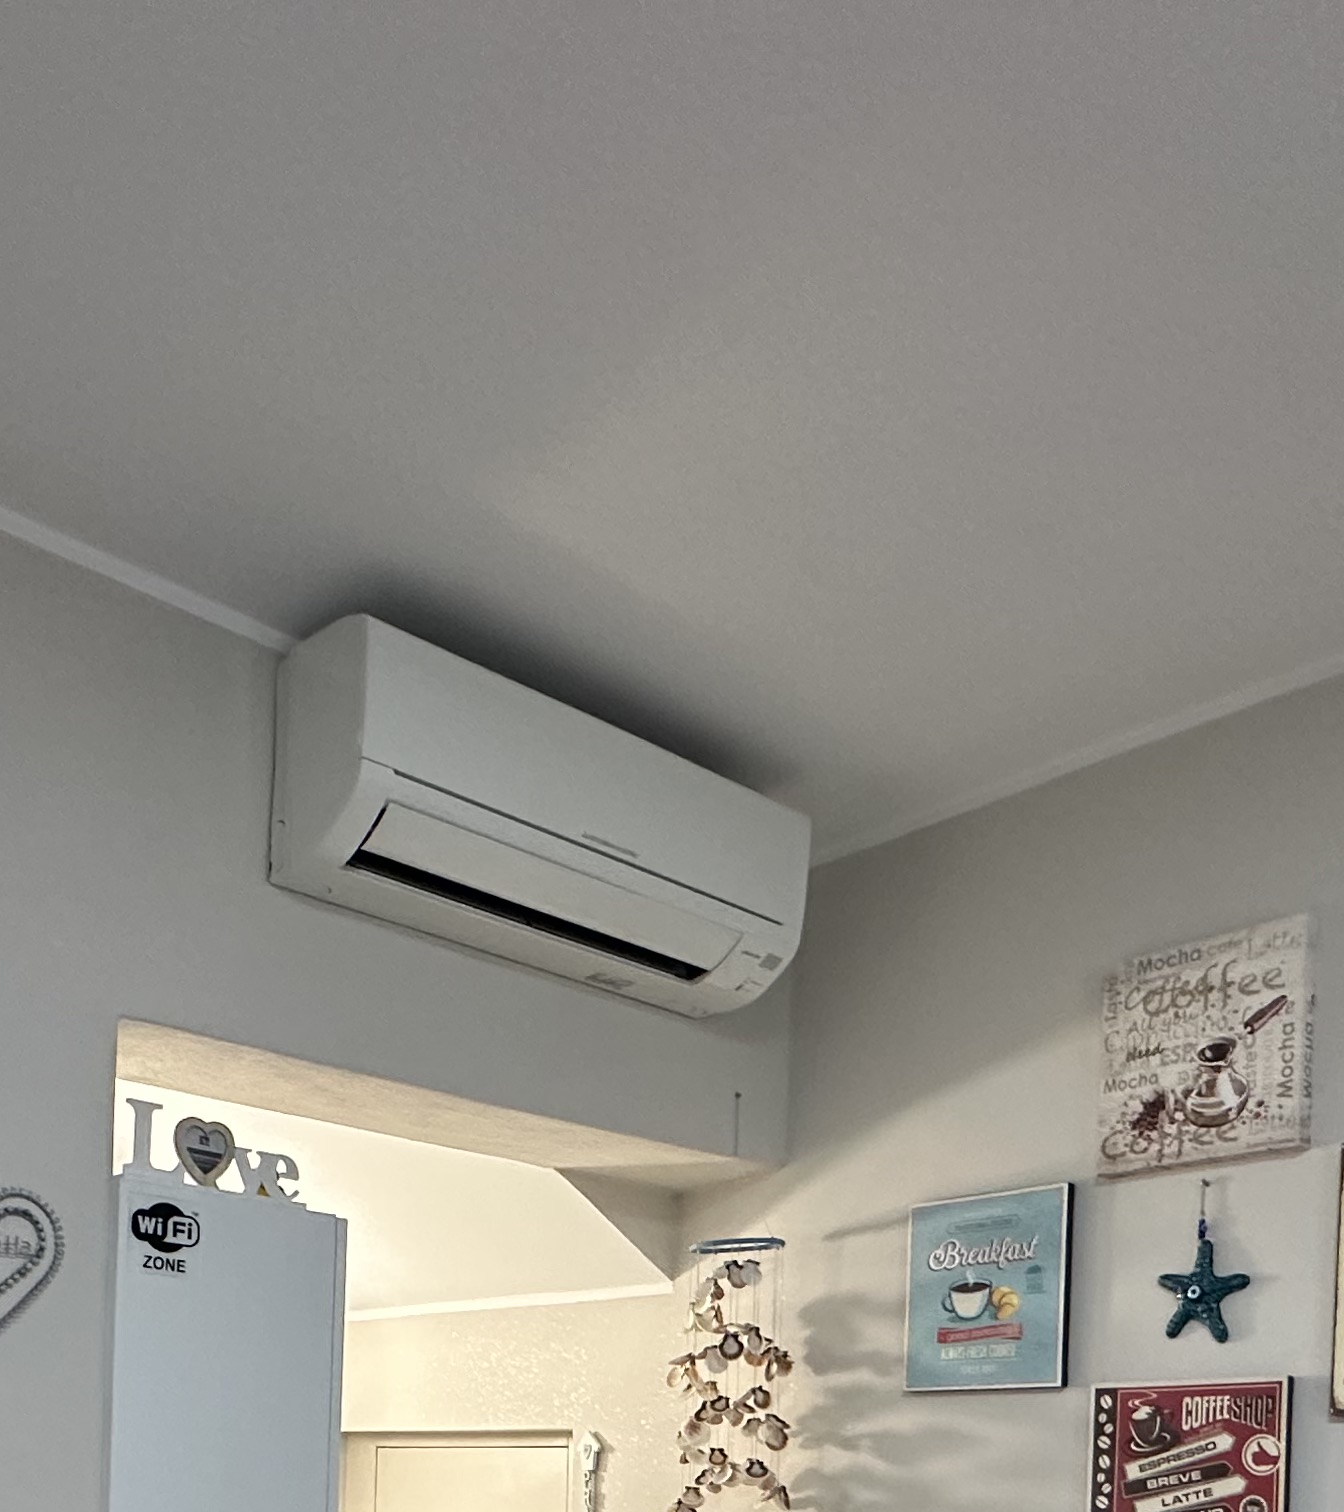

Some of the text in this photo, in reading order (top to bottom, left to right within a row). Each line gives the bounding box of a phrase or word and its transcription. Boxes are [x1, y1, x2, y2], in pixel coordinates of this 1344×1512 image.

[1136, 947, 1202, 977] Mocha
[1277, 1022, 1296, 1099] Mocha
[1103, 1073, 1159, 1094] Mocha
[142, 1255, 187, 1273] ZONE
[927, 1234, 1040, 1272] Breakfast
[1181, 1395, 1230, 1431] COFFEE
[1138, 1440, 1217, 1473] ESPRESSO
[1146, 1470, 1202, 1490] BREVE
[1161, 1488, 1214, 1508] LATTE
